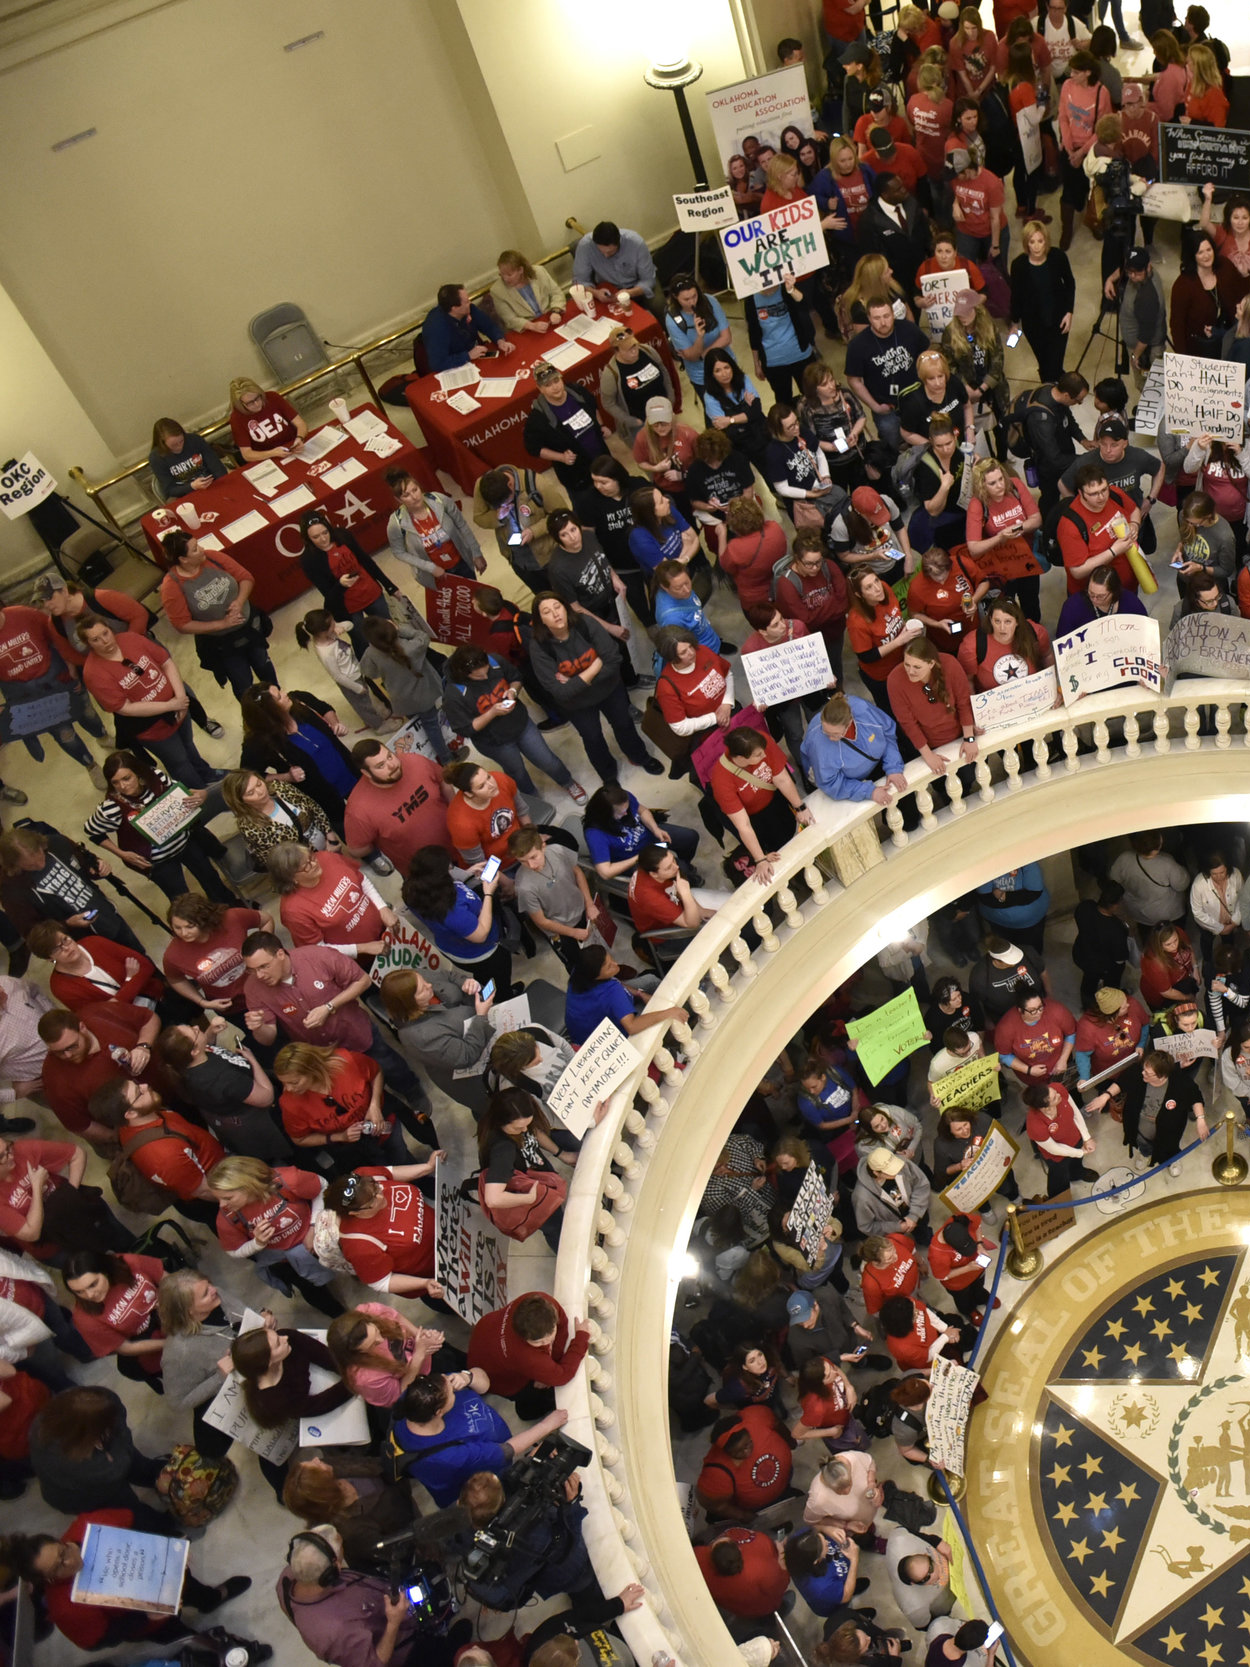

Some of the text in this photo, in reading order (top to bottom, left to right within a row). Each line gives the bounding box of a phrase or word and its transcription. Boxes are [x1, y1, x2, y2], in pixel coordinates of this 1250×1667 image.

[712, 89, 759, 109] OKLAHOMA
[733, 93, 777, 113] EDUCATION
[755, 95, 806, 118] ASSOCIATION
[1166, 127, 1191, 140] When
[1194, 130, 1237, 147] Something
[1168, 151, 1249, 169] you find way to
[1186, 162, 1230, 179] AFFORD IT
[675, 189, 729, 205] Southeast
[687, 204, 725, 219] Region
[724, 200, 814, 248] OUR KIDS
[755, 229, 790, 253] ARE
[738, 232, 817, 276] WORTH
[759, 261, 795, 288] IT!
[1165, 354, 1238, 374] My Students
[1166, 370, 1236, 388] can't HALF
[1168, 380, 1184, 392] DO
[1203, 398, 1225, 407] can
[249, 413, 288, 442] OEA
[1168, 414, 1197, 428] their
[1226, 410, 1240, 423] DO
[0, 468, 46, 506] Region
[1, 463, 31, 489] OKC
[456, 623, 472, 643] ALL
[1057, 628, 1089, 656] MY
[1237, 631, 1247, 643] A
[1084, 650, 1097, 666] I
[1113, 656, 1160, 674] CLASS
[392, 785, 430, 823] YMS
[560, 1088, 579, 1120] CAN'T
[580, 1056, 601, 1087] KEEP
[941, 1067, 993, 1107] TEACHERS
[953, 1138, 995, 1191] TEACHING
[1124, 1204, 1237, 1259] THE
[472, 1231, 486, 1322] There
[1060, 1254, 1117, 1304] OF
[983, 1308, 1071, 1444] SEAL
[979, 1459, 1067, 1647] GREAT
